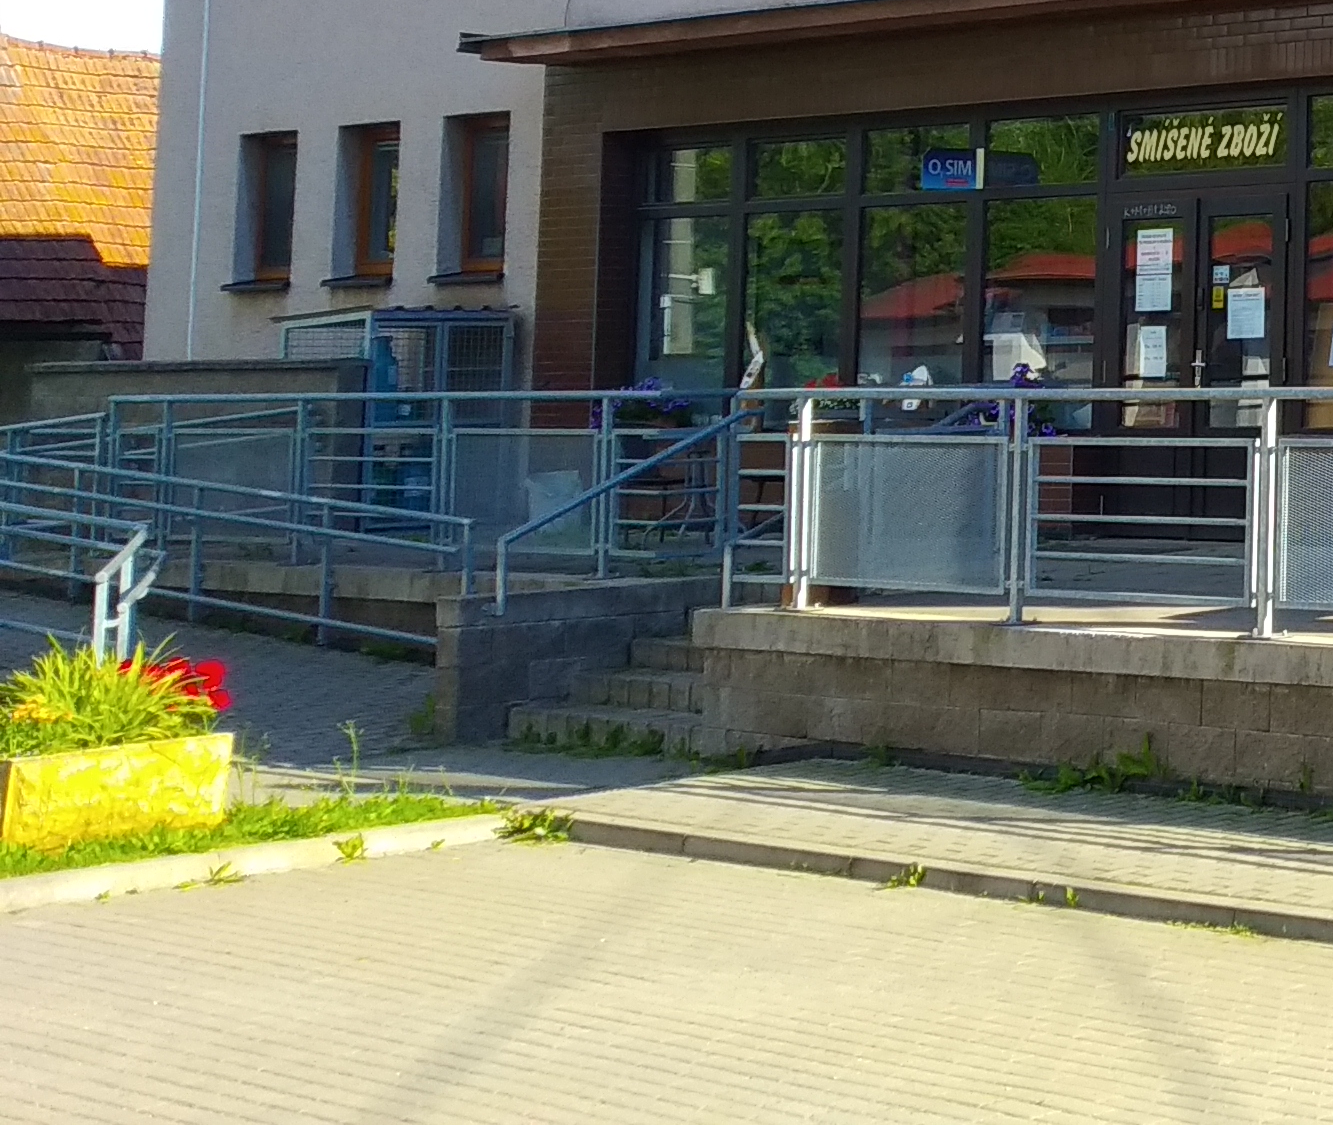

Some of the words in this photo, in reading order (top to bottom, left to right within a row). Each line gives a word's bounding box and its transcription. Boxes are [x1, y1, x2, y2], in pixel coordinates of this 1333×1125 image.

[1126, 117, 1214, 164] SMÍŠENÉ
[1216, 112, 1284, 159] ZBOŽÍ
[945, 159, 972, 176] SIM
